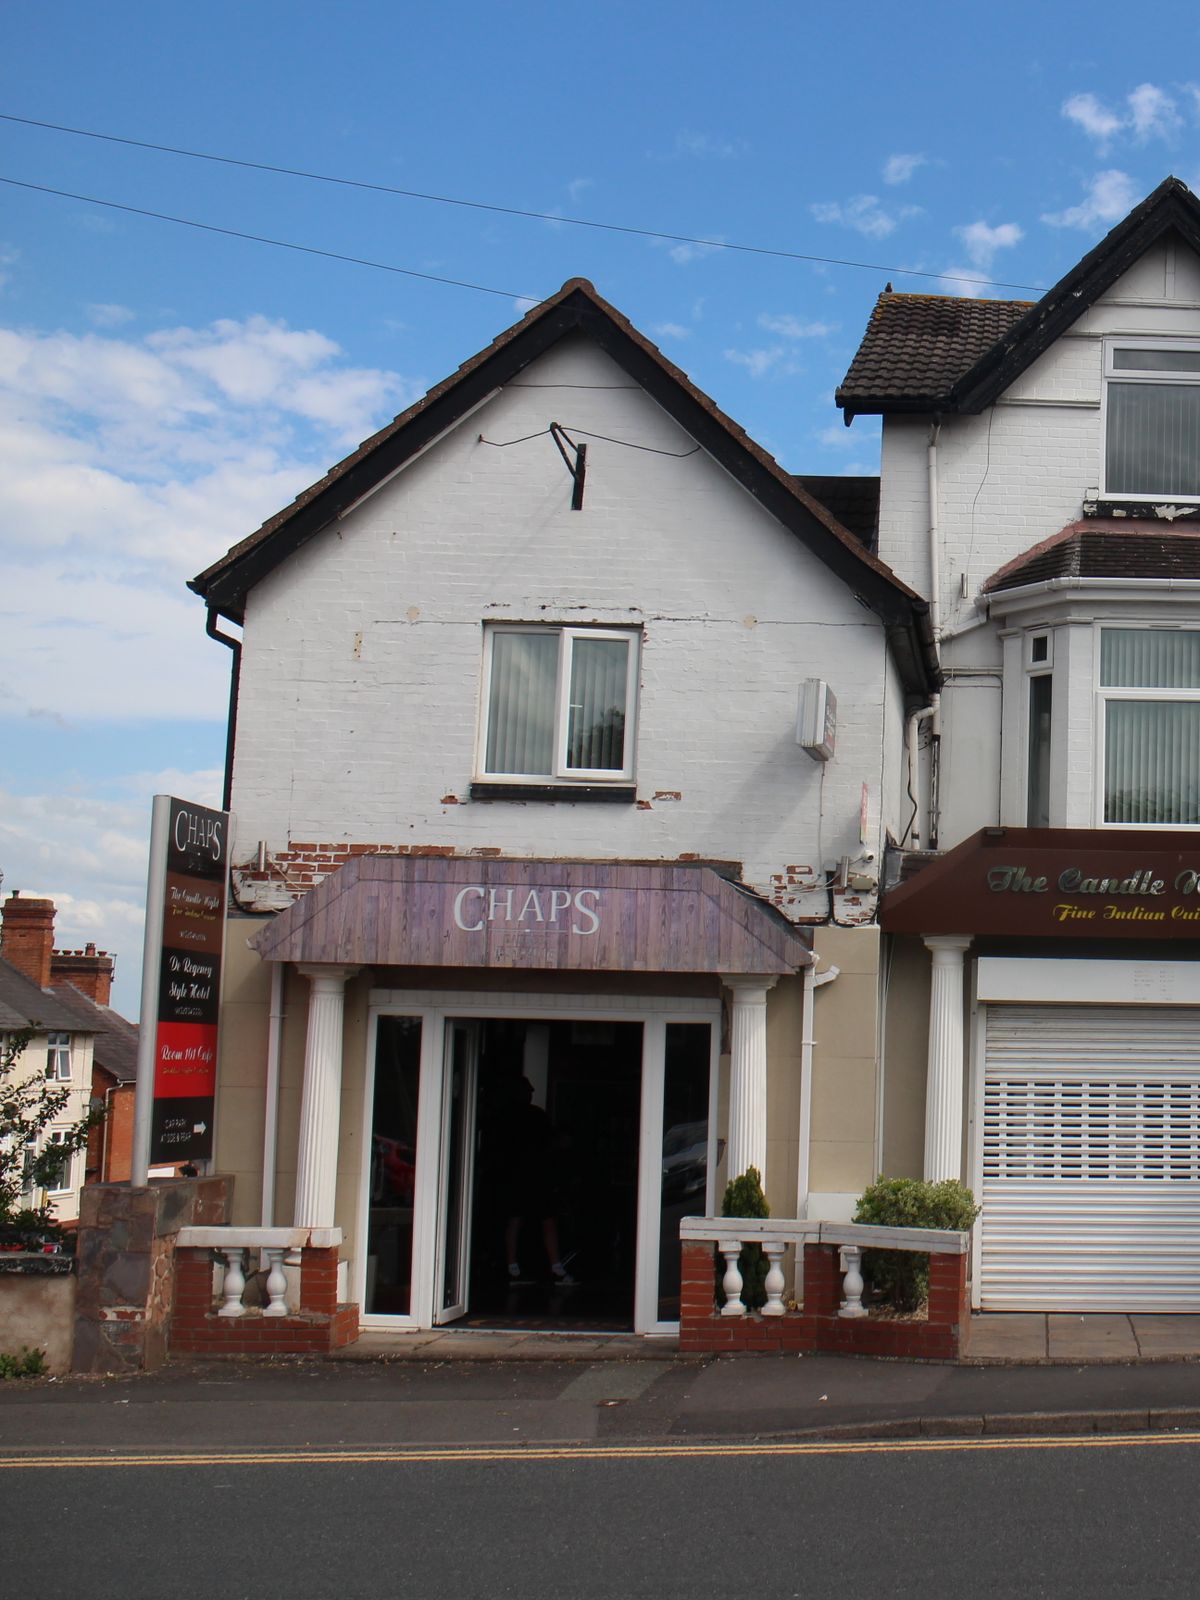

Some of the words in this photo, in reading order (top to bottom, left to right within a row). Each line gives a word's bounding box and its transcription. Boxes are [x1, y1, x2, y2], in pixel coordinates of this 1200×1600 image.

[175, 810, 222, 861] CHAPS
[986, 866, 1049, 893] The
[1058, 867, 1166, 895] Candle
[453, 886, 601, 935] CHAPS
[1052, 904, 1097, 922] Fine
[1103, 905, 1167, 920] Indian
[183, 957, 213, 978] Regency
[168, 981, 188, 1000] Style
[190, 983, 211, 999] Hotel
[161, 1045, 183, 1060] Room
